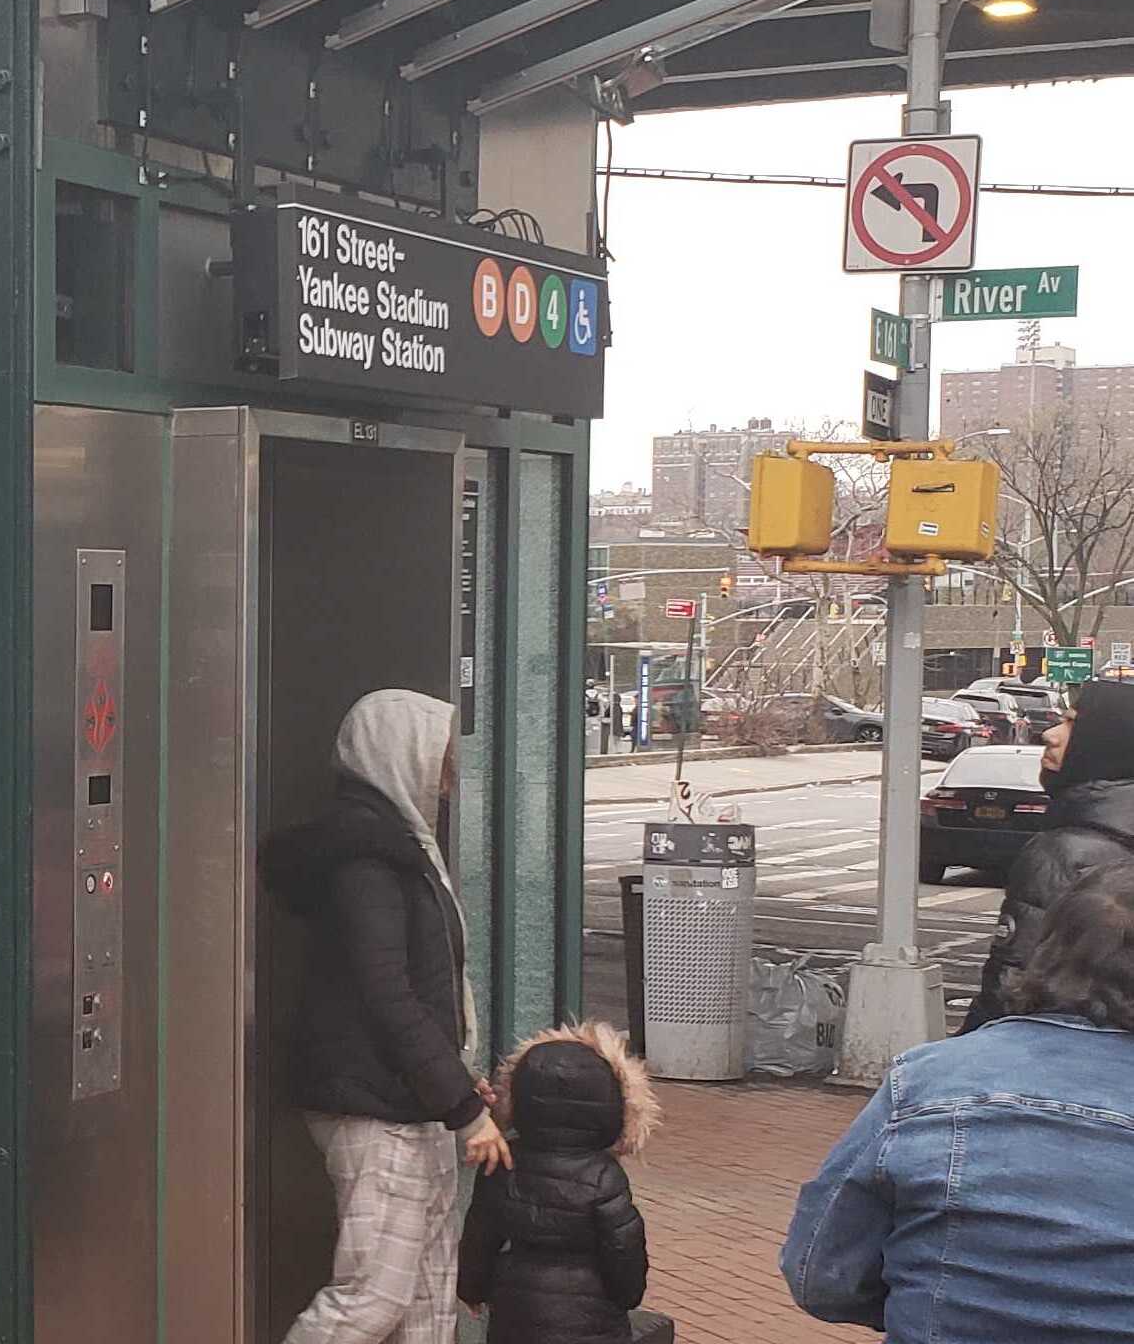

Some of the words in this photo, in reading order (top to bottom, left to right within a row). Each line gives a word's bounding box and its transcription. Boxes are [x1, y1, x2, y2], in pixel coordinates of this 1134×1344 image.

[298, 216, 329, 259] 161
[337, 224, 405, 273] Street-
[298, 265, 369, 314] Yankee
[377, 281, 449, 330] Stadium
[482, 276, 496, 317] B
[516, 284, 530, 324] D
[547, 291, 559, 329] 4
[954, 277, 1026, 315] River
[1038, 271, 1061, 295] Av
[299, 314, 375, 369] Subway
[382, 327, 445, 373] Station
[875, 317, 882, 354] E
[884, 319, 897, 359] 161
[871, 396, 887, 423] ONE
